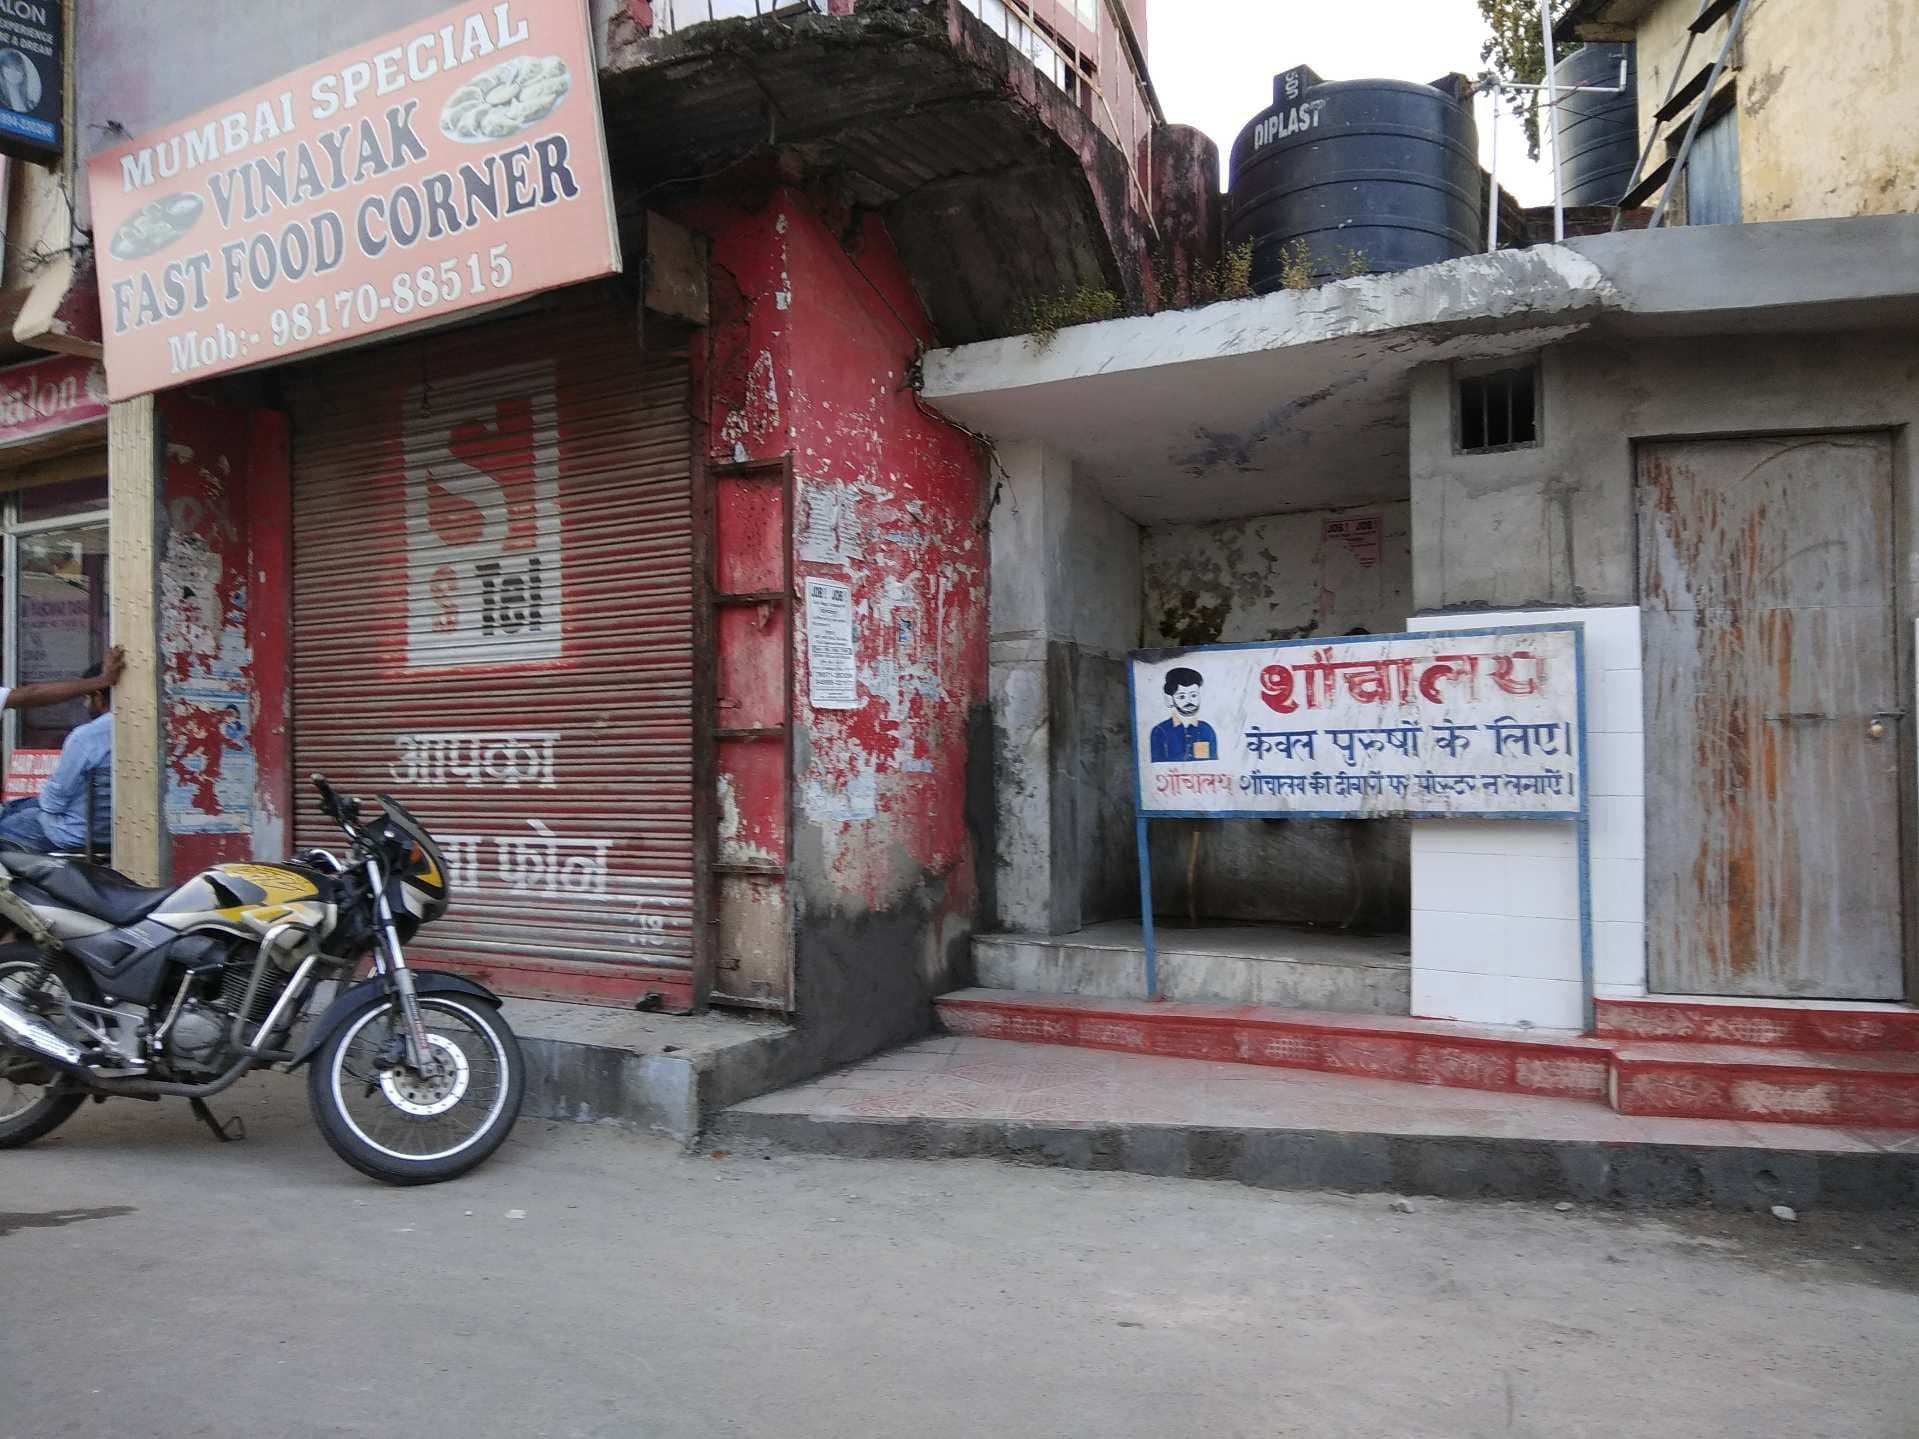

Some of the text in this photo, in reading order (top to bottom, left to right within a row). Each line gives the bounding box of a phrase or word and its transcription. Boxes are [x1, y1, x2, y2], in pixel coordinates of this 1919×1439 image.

[120, 2, 529, 192] MUMBAI SPECIAL
[208, 97, 428, 230] VINAYAK
[111, 134, 580, 335] FAST FOOD CORNER
[271, 243, 513, 347] 98170-88515
[388, 732, 561, 789] आपका
[1244, 725, 1318, 763] केवल
[1432, 718, 1478, 758] के
